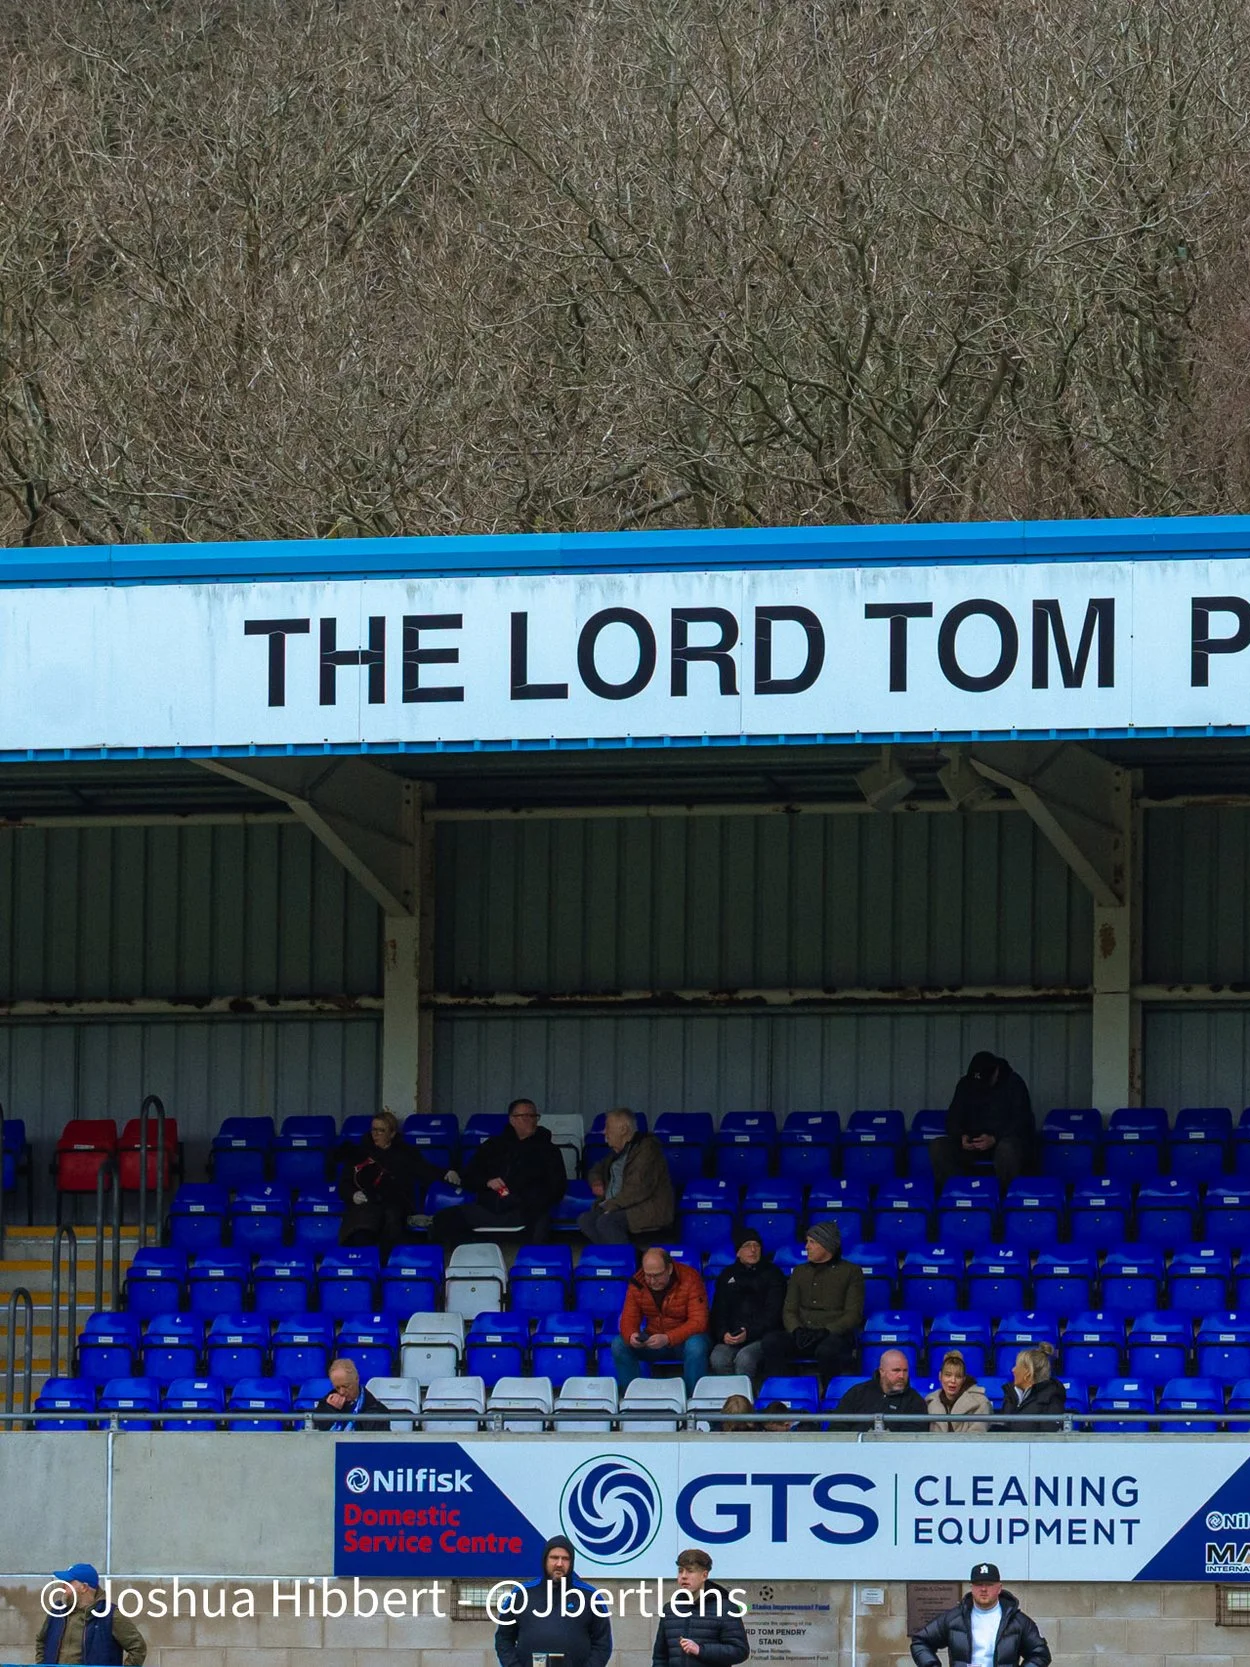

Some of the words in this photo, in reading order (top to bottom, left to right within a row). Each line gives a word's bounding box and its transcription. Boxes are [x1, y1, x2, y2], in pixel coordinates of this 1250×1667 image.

[245, 614, 463, 707] THE
[511, 606, 825, 701] LORD
[865, 598, 1115, 693] TOM
[373, 1468, 473, 1493] Nilfisk
[914, 1475, 1139, 1507] CLEANING
[344, 1503, 460, 1526] Domestic
[676, 1473, 879, 1545] GTS
[344, 1530, 432, 1553] Service
[439, 1530, 523, 1553] Centre
[914, 1518, 1140, 1545] EQUIPMENT
